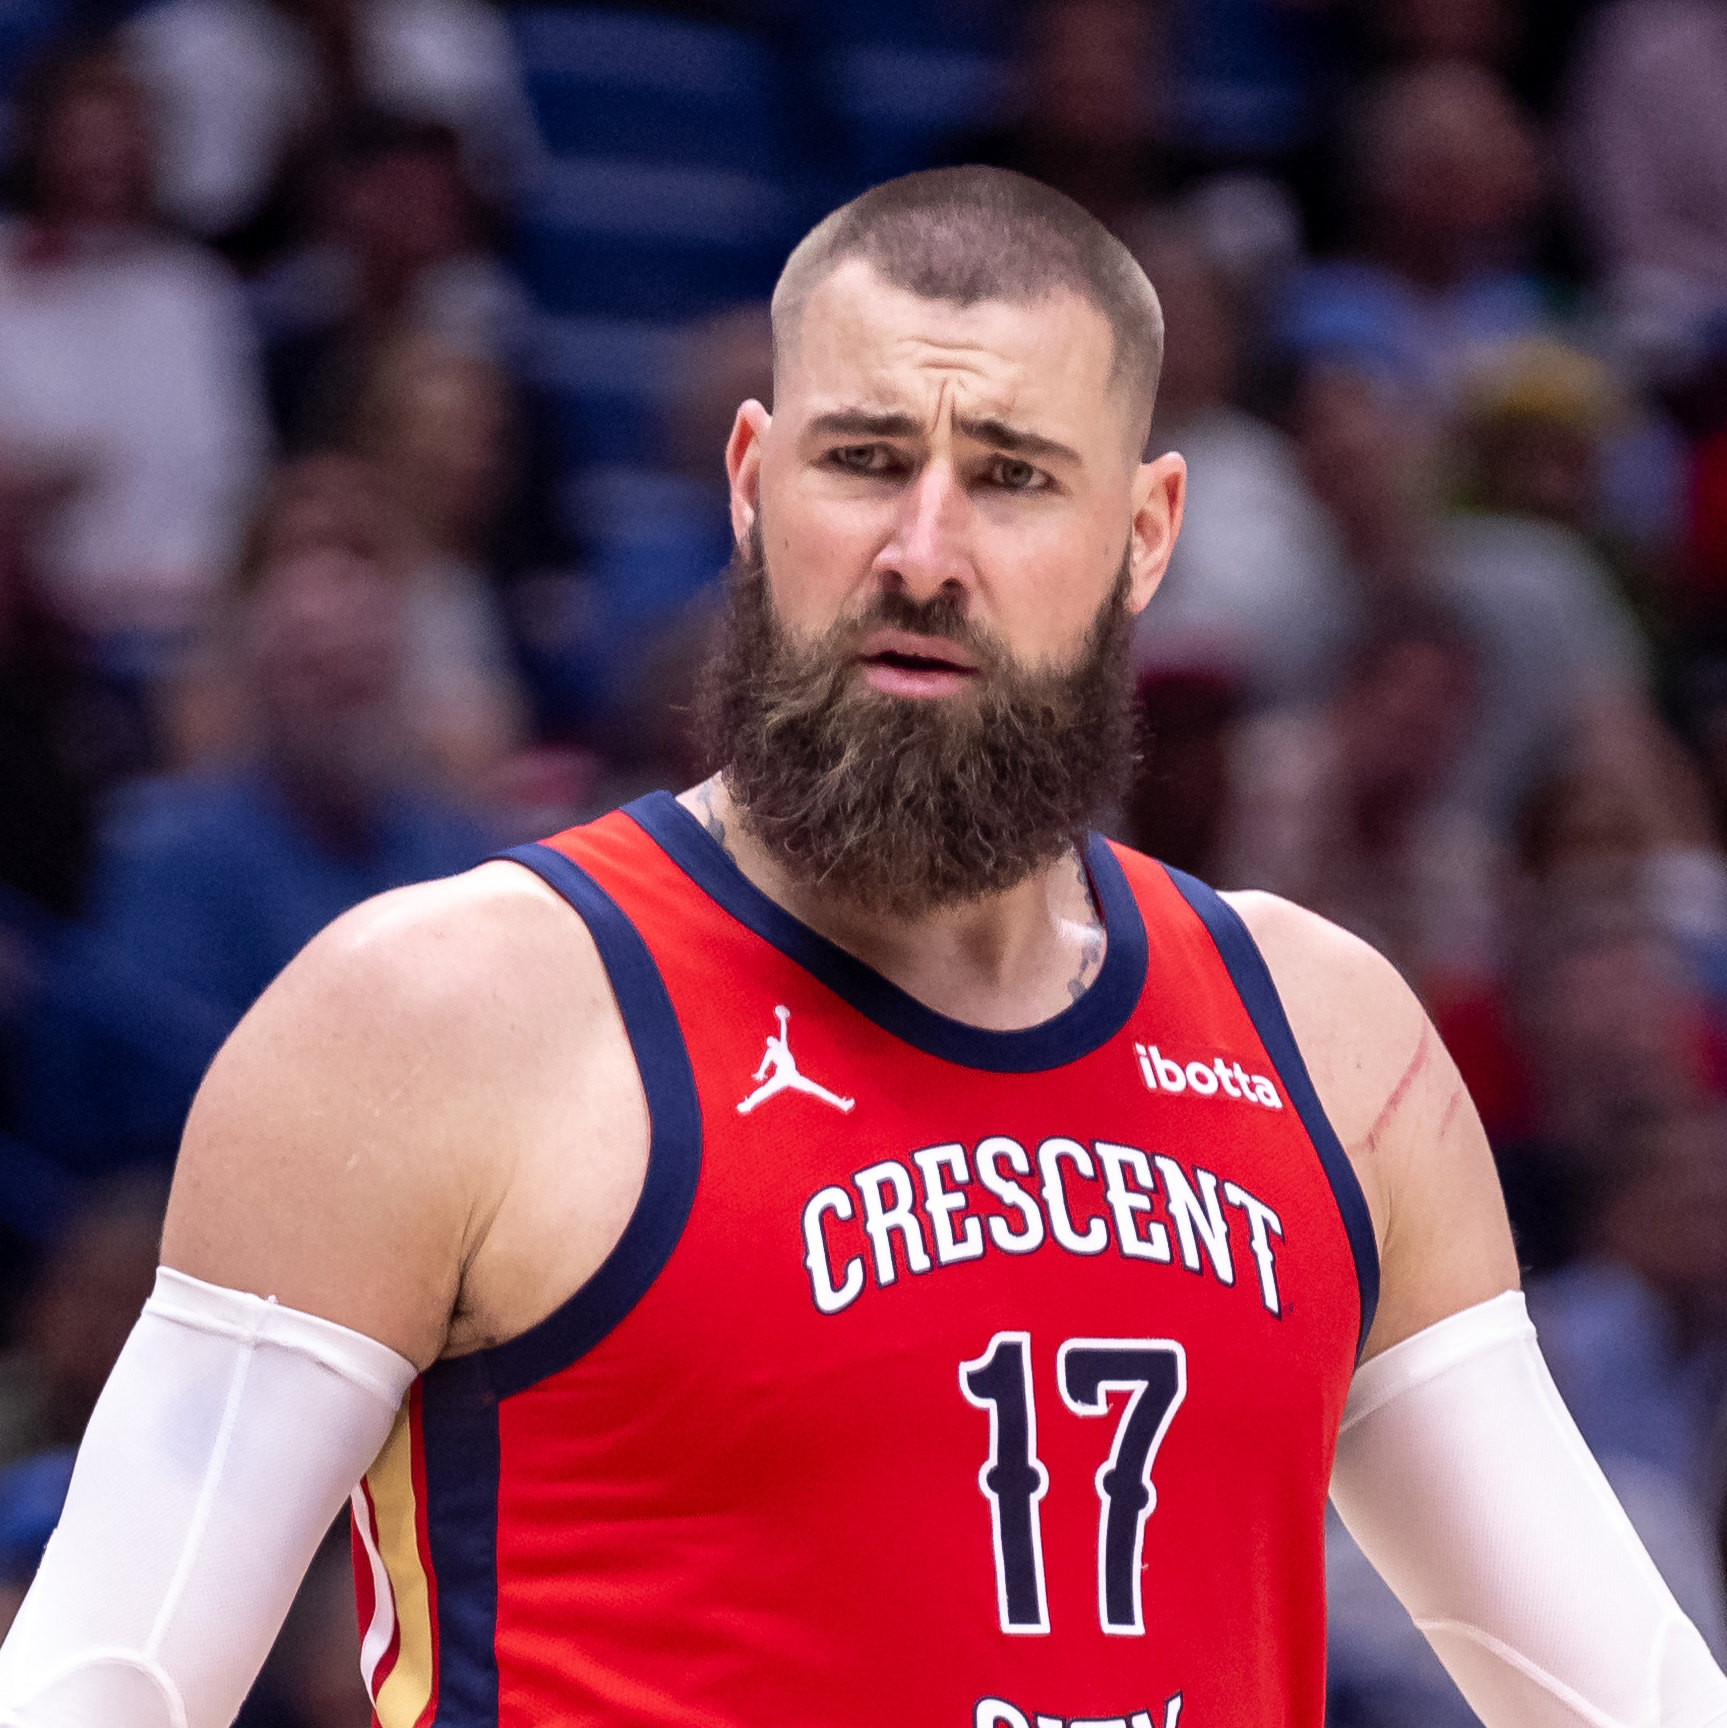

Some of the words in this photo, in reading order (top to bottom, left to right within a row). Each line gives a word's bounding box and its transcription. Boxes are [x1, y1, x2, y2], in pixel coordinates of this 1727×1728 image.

[1135, 1042, 1283, 1109] ibotta
[802, 1136, 1284, 1319] CRESCENT
[959, 1332, 1187, 1635] 17
